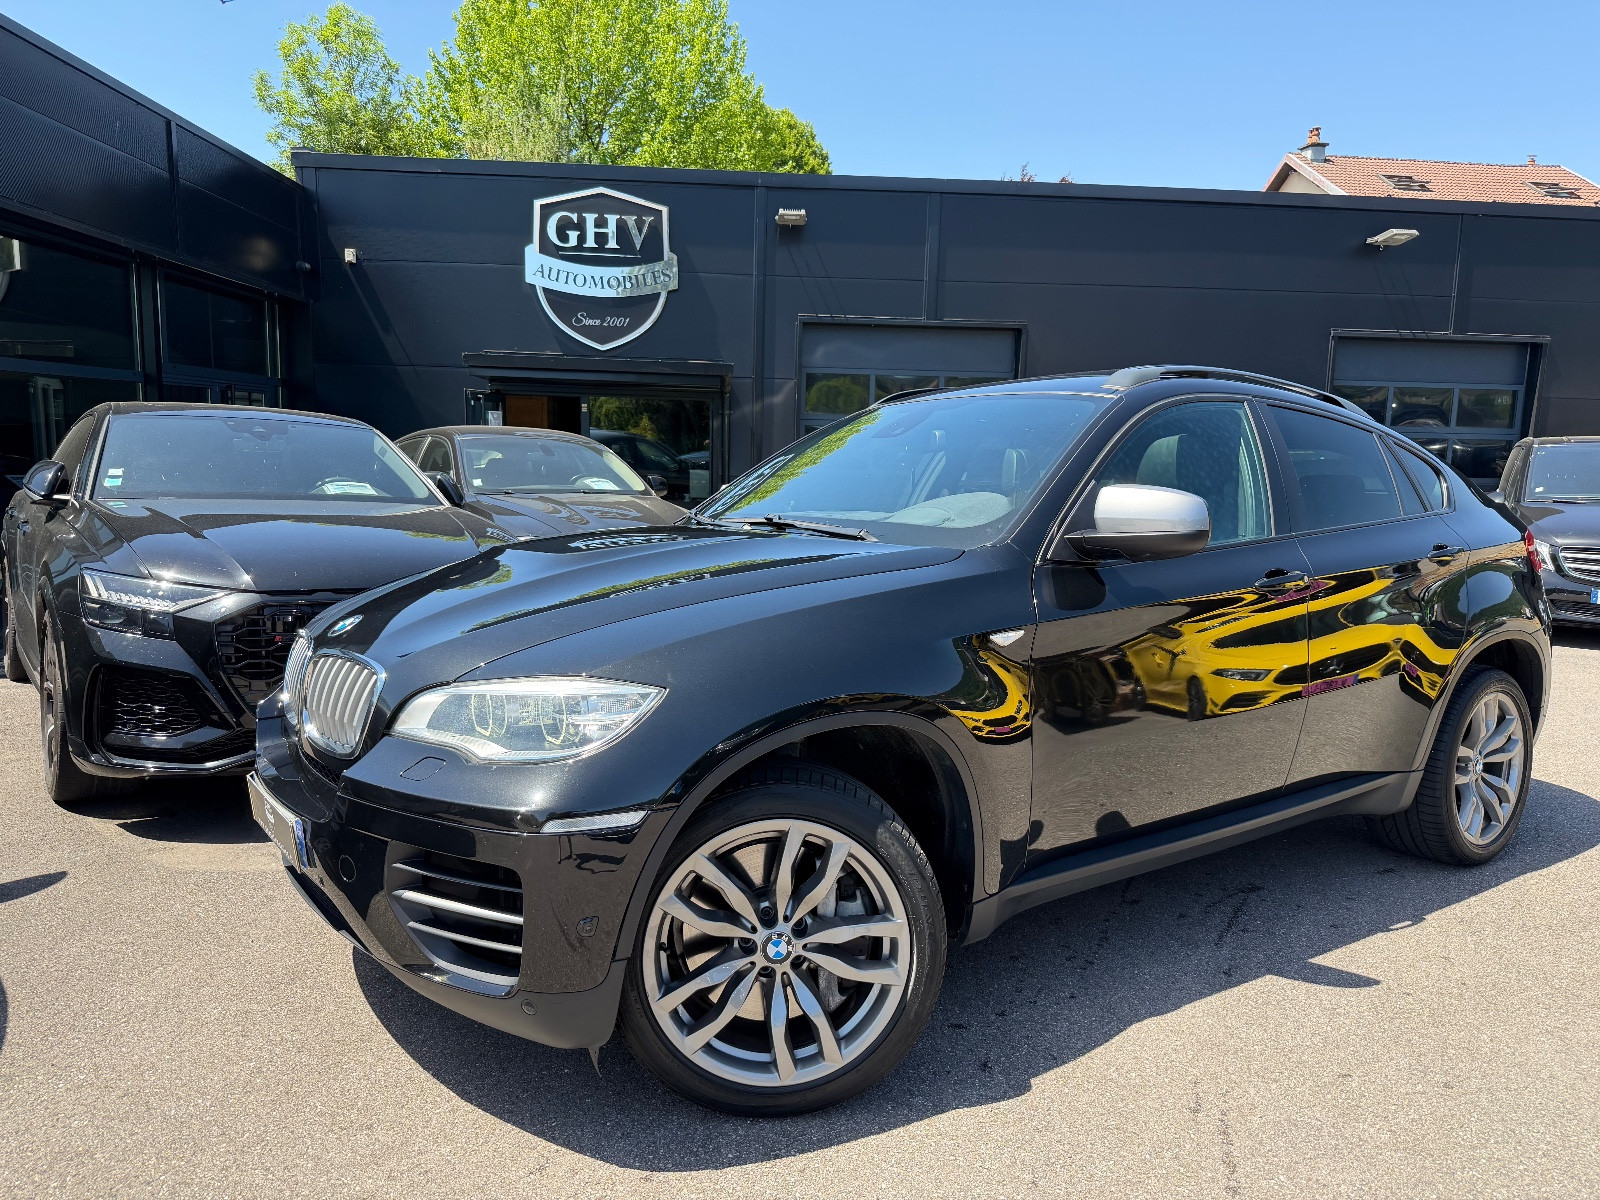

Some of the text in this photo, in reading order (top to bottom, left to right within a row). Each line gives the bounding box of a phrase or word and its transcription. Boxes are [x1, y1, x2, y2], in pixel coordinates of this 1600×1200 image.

[546, 211, 654, 251] GHV
[533, 263, 672, 290] AUTOMOBILES
[572, 312, 631, 327] Since 2001
